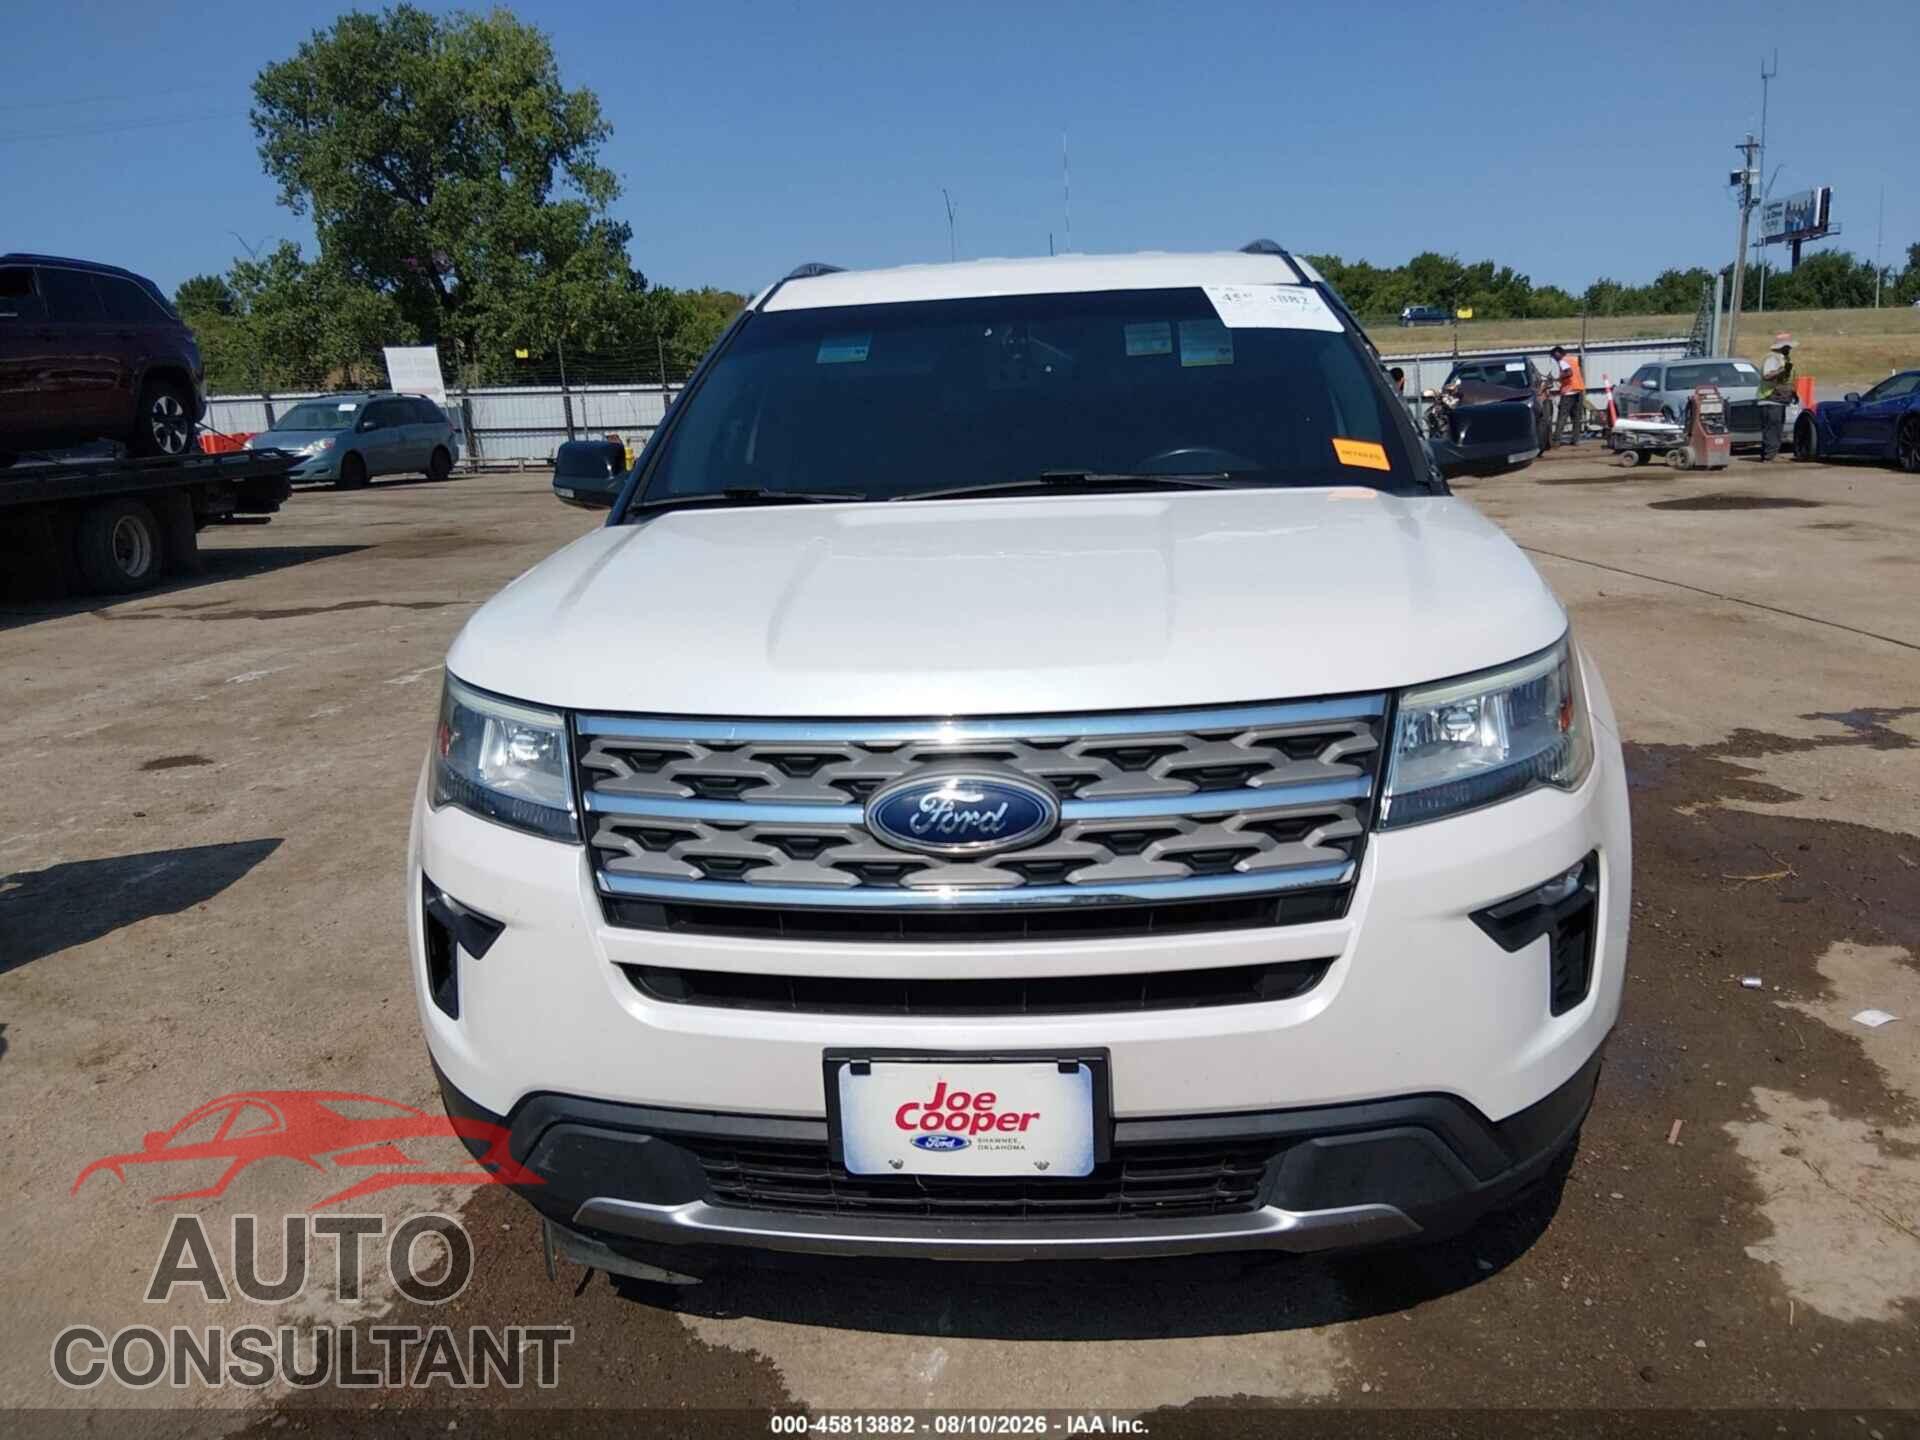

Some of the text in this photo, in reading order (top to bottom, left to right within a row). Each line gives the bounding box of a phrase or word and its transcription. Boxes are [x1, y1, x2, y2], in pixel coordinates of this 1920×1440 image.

[909, 788, 1009, 835] Ford
[923, 1081, 997, 1112] Joe
[894, 1102, 1041, 1136] Cooper
[924, 1136, 957, 1149] Ford
